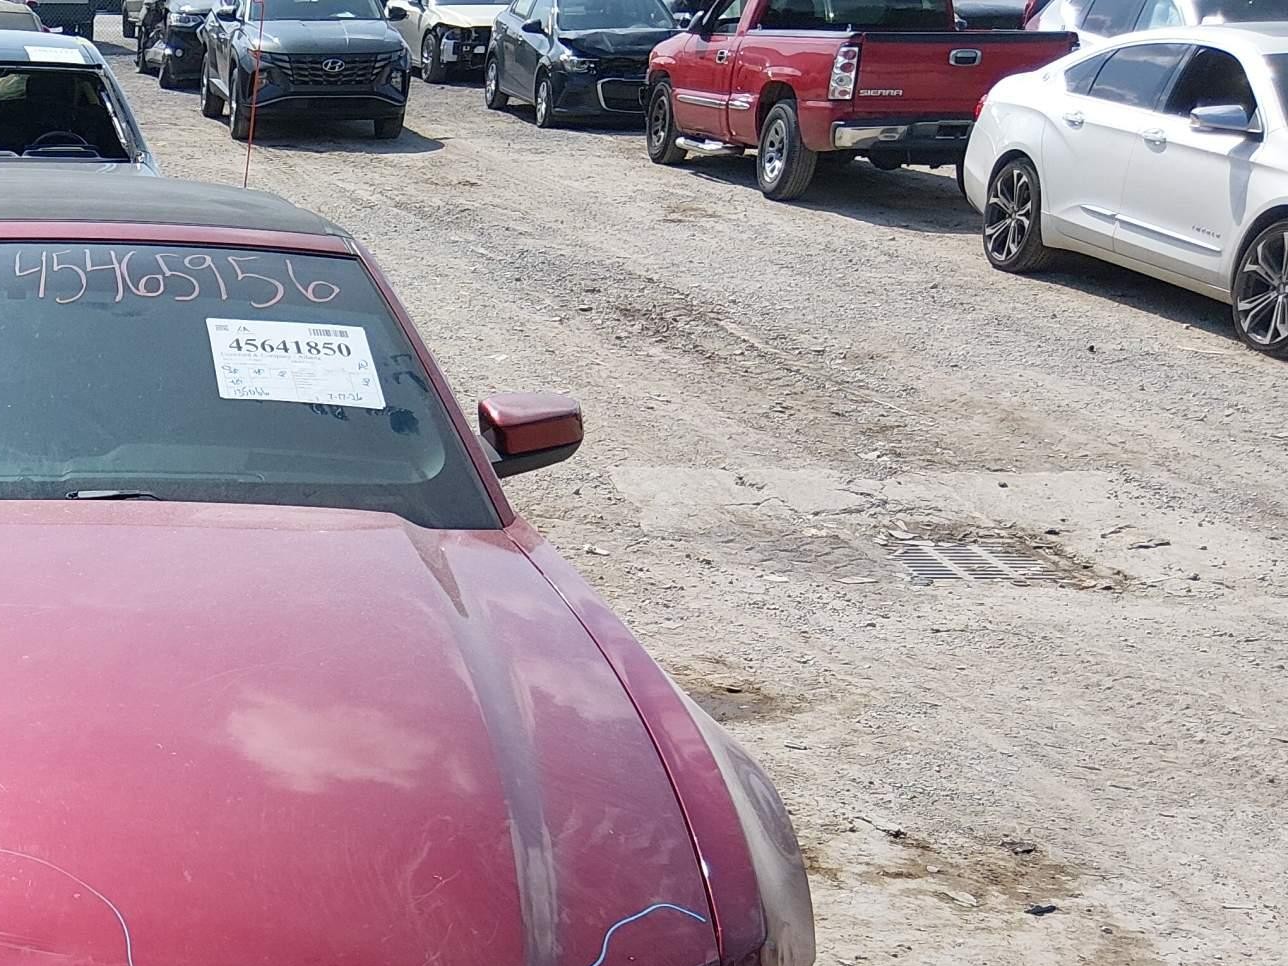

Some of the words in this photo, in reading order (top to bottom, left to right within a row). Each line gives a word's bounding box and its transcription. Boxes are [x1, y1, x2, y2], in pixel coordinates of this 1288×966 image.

[858, 89, 903, 97] SIERRA
[15, 249, 340, 308] 45465956
[229, 337, 352, 358] 45641850
